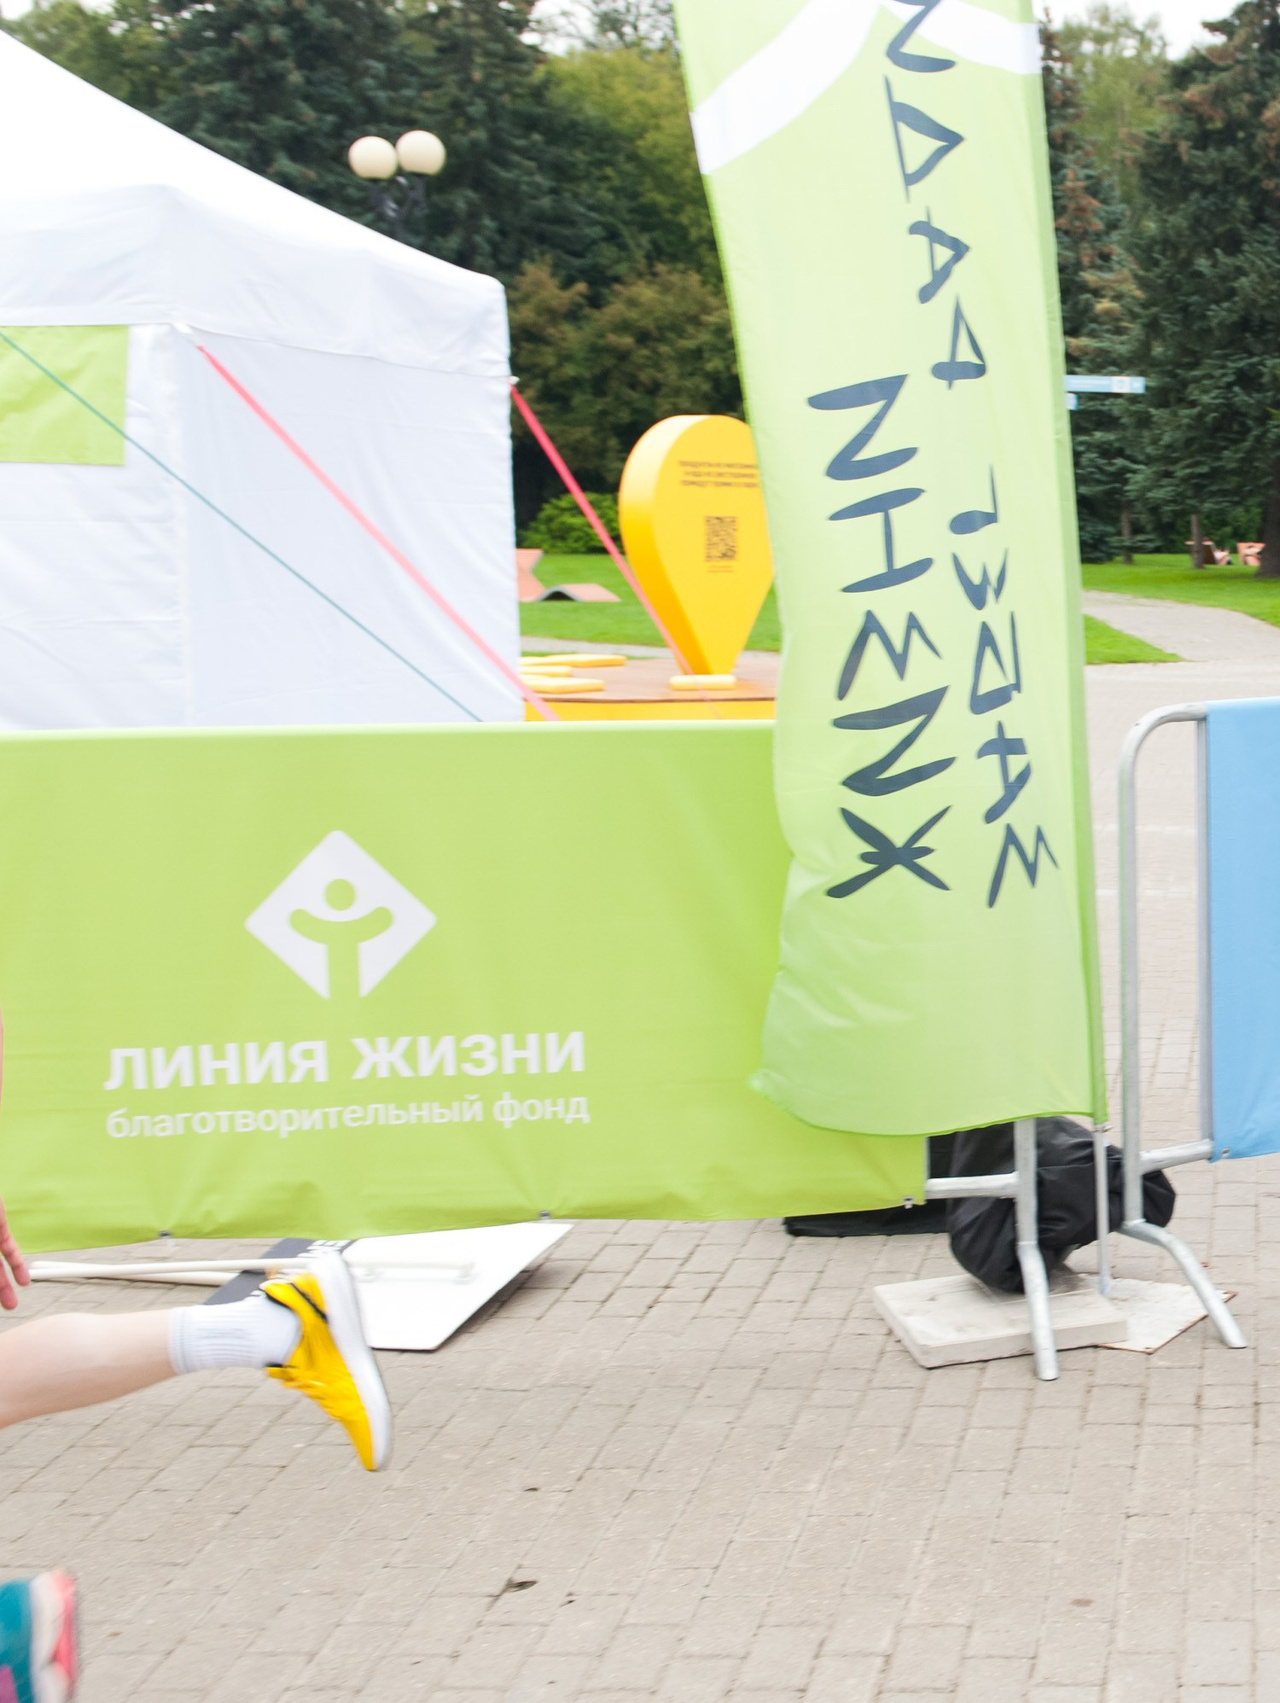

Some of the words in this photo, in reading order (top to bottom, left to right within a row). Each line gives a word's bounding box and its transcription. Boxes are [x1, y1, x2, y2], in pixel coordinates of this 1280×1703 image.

[103, 1039, 328, 1090] ЛИНИЯ
[350, 1030, 586, 1080] ЖИЗНИ
[105, 1094, 484, 1138] благотворительный
[492, 1091, 592, 1128] фонд
